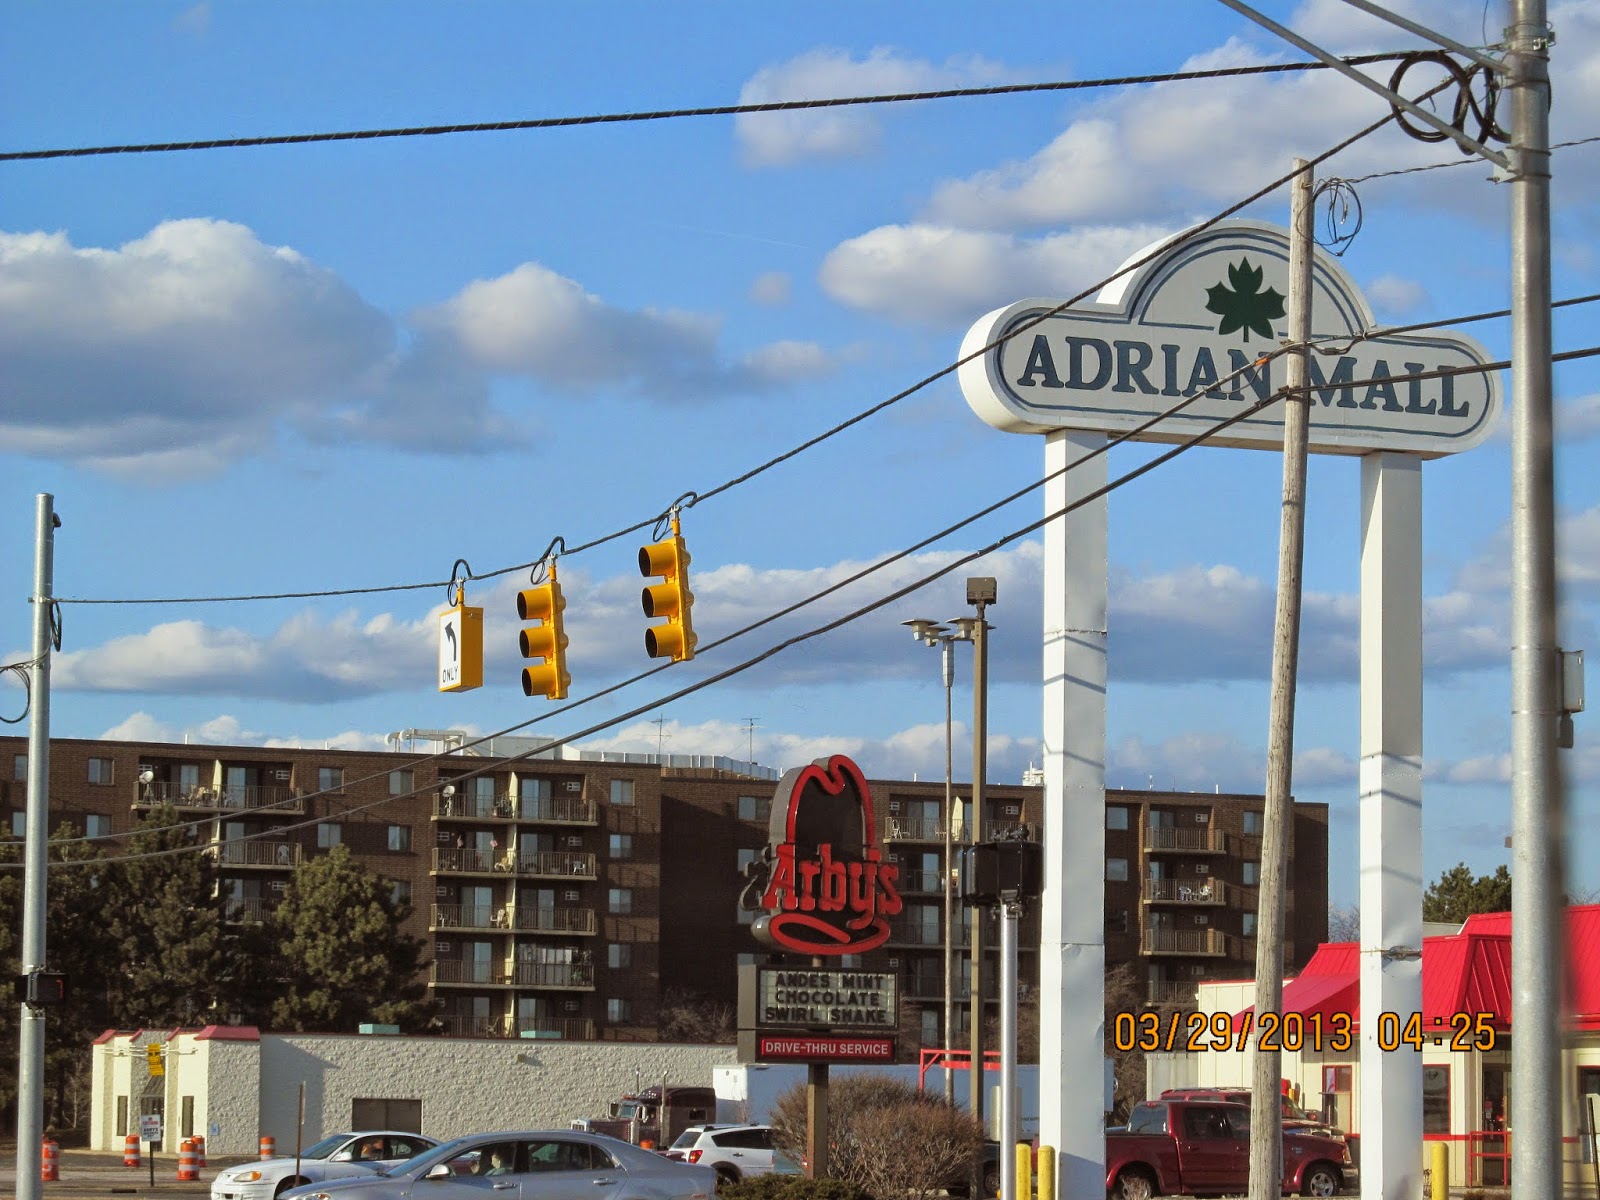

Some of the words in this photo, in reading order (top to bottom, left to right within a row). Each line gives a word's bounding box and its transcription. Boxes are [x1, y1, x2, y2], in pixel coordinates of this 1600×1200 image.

[1017, 334, 1273, 403] ADRIAN
[1310, 355, 1470, 418] MALL
[442, 666, 459, 683] ONLY
[775, 972, 831, 988] ANDES
[842, 974, 884, 990] MINT
[775, 990, 880, 1007] CHOCOLATE
[765, 1006, 820, 1022] SWIRL
[830, 1008, 887, 1024] SHAKE
[765, 1042, 836, 1054] DRIVE-THRU
[839, 1043, 889, 1055] SERVICE
